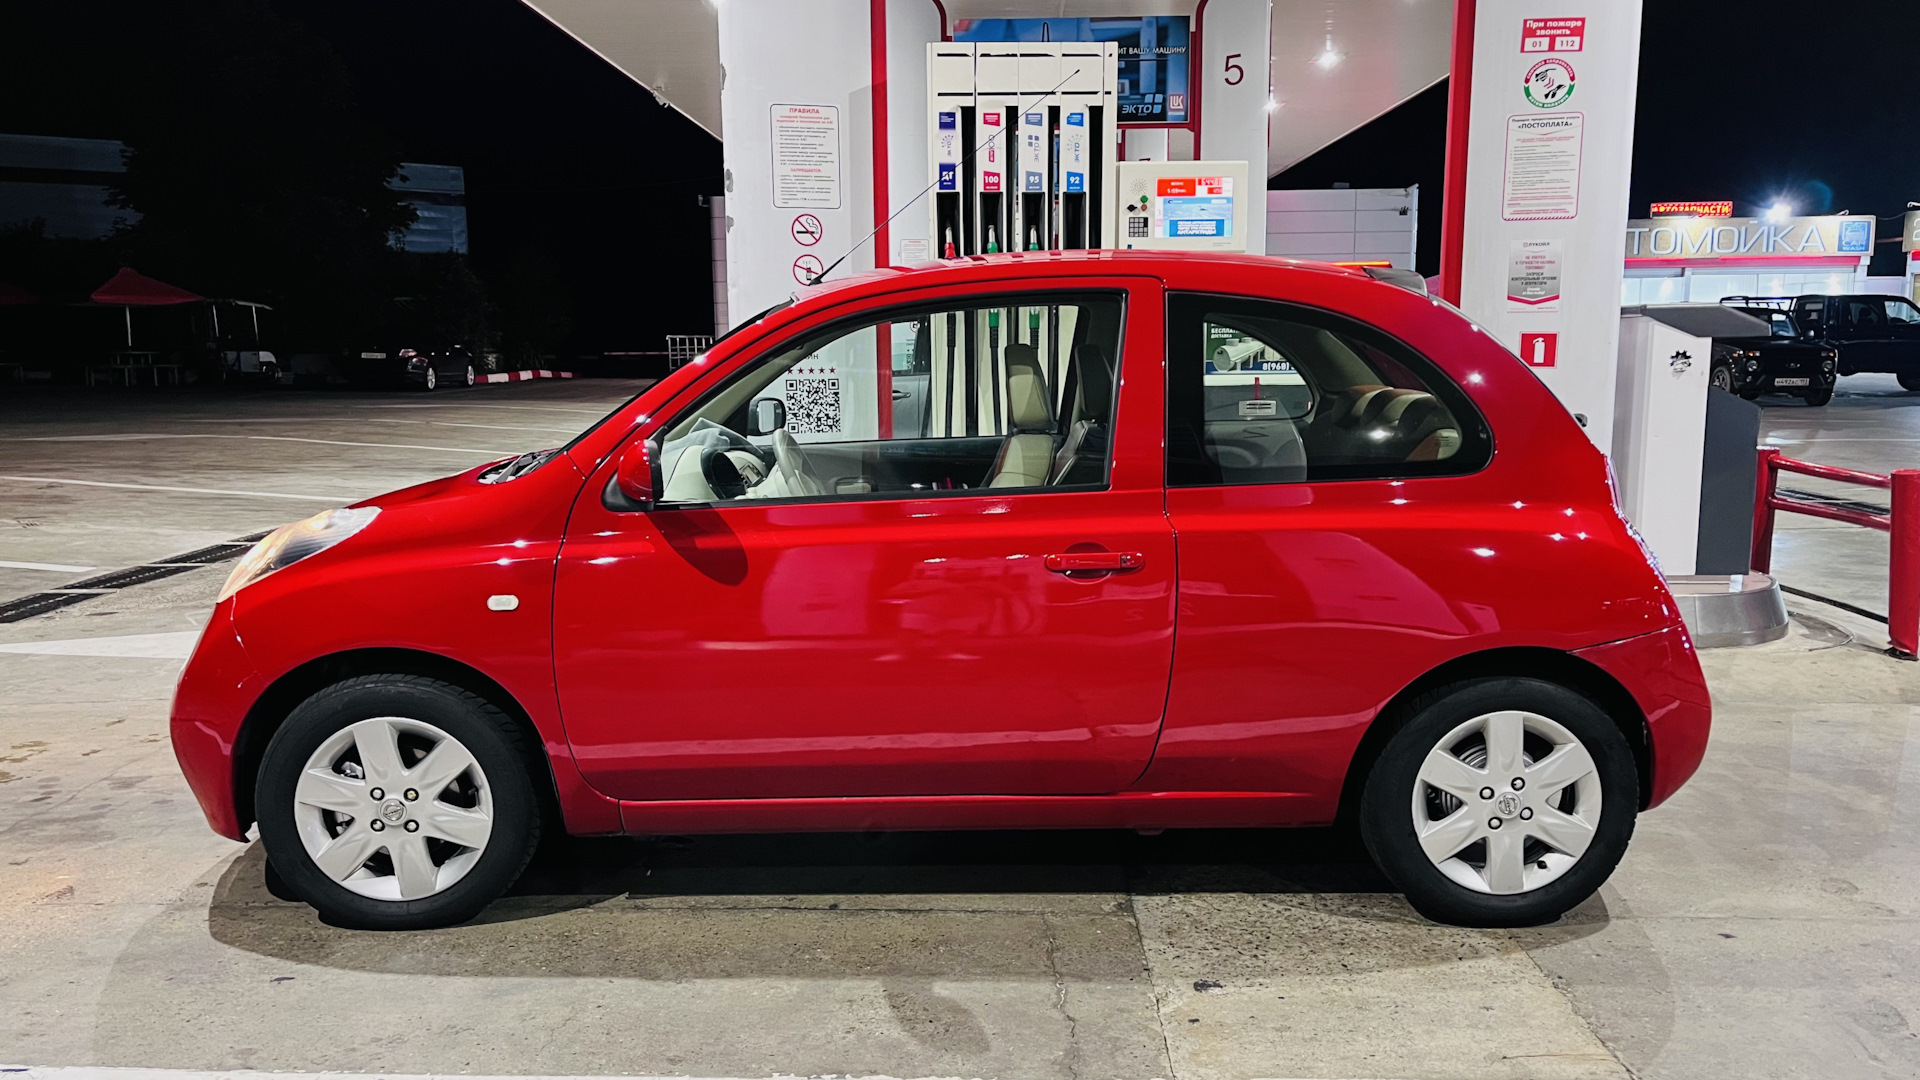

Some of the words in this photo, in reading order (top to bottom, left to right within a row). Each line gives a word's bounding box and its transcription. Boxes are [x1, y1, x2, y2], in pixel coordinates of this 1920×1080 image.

[1526, 20, 1544, 29] При
[1546, 20, 1582, 28] пожаре
[1535, 28, 1571, 36] звонить
[1532, 40, 1542, 48] 01
[1128, 47, 1149, 55] ВАШУ
[1152, 46, 1186, 54] МАШИНУ
[1223, 53, 1245, 86] 5
[1121, 104, 1152, 114] ЭКТО
[984, 175, 999, 184] 100
[1029, 175, 1040, 183] 95
[1069, 176, 1080, 184] 92
[1262, 362, 1290, 370] 8(968)
